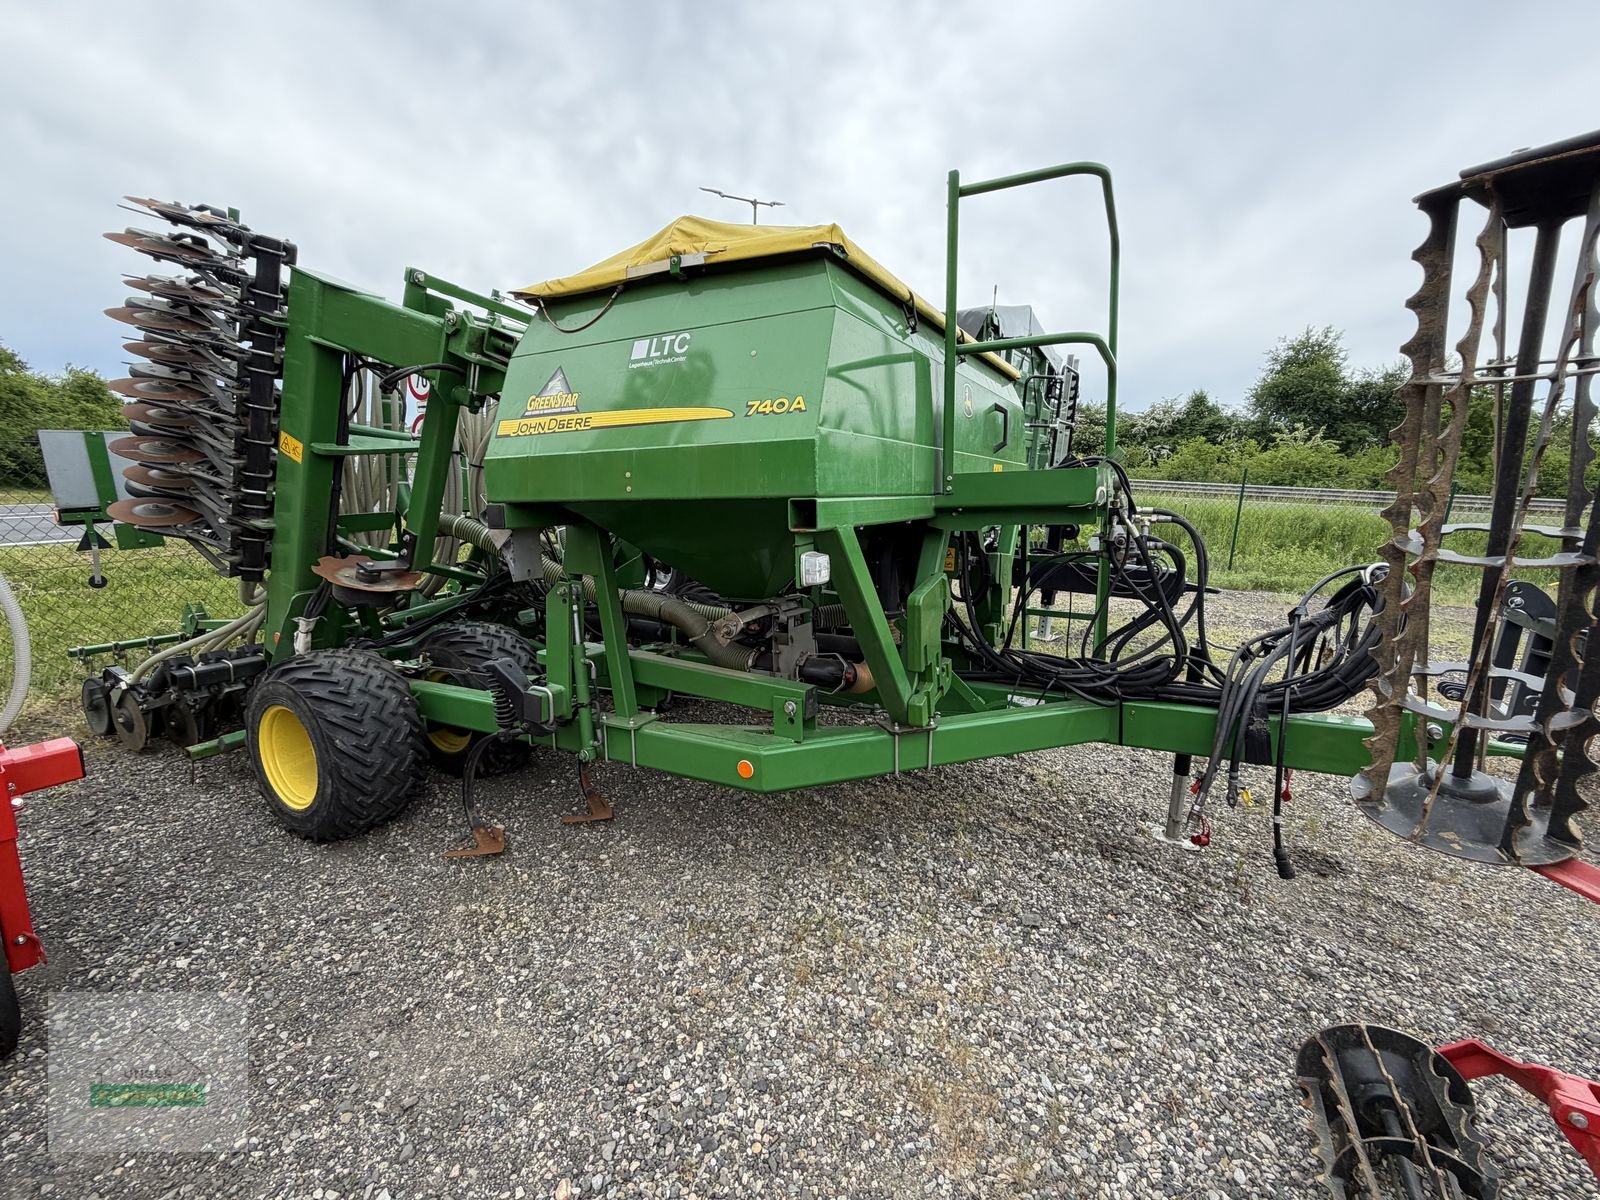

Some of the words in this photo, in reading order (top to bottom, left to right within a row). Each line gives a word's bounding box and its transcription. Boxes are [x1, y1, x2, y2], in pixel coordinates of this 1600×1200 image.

[650, 332, 691, 357] LTC
[745, 395, 807, 417] 740A
[512, 420, 547, 435] JOHN
